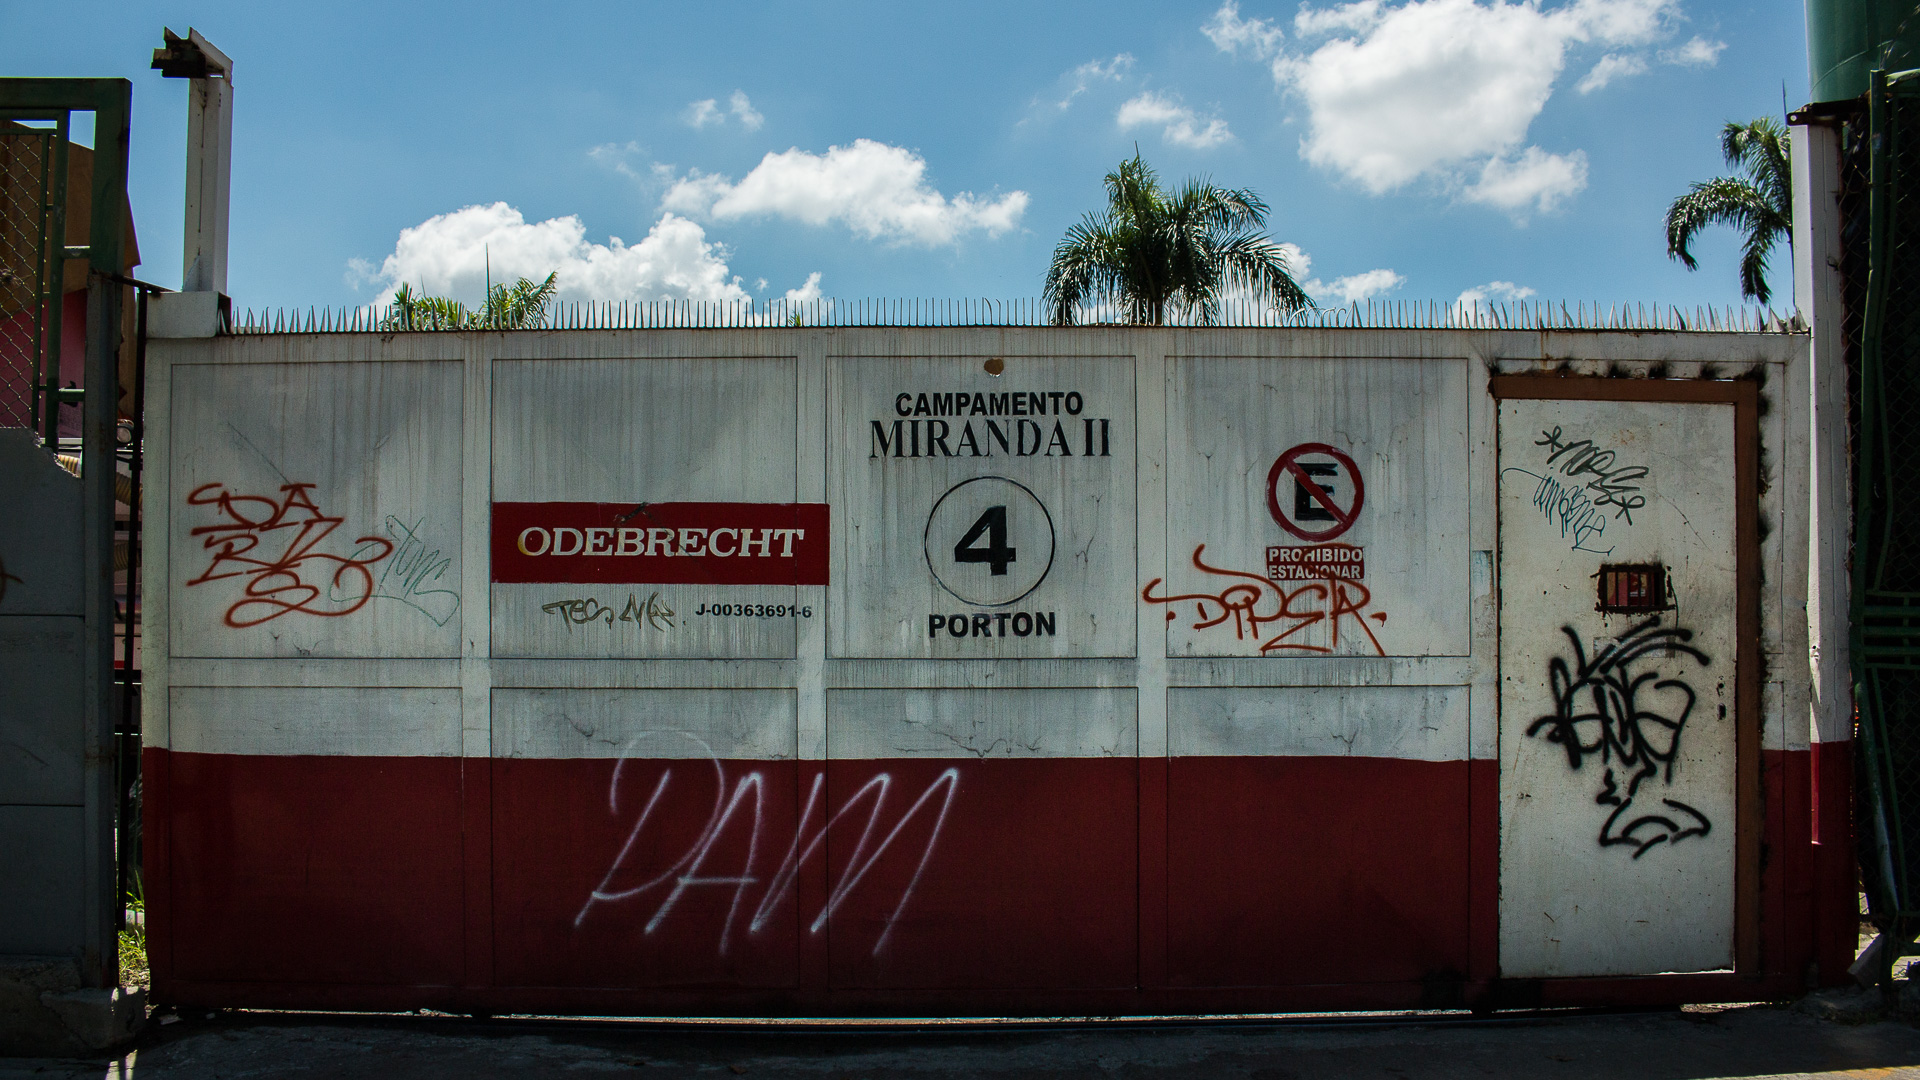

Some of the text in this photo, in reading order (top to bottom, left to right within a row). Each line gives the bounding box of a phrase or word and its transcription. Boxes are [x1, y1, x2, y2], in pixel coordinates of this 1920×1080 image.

[895, 391, 1083, 417] CAMPAMENTO
[869, 418, 1112, 458] MIRANDA II
[517, 526, 805, 558] ODEBRECHT
[954, 505, 1017, 576] 4
[1268, 548, 1363, 562] PROHIBIDO
[1268, 564, 1362, 579] ESTACIONAR
[695, 603, 813, 619] J-00363691-6
[928, 611, 1056, 638] PORTON
